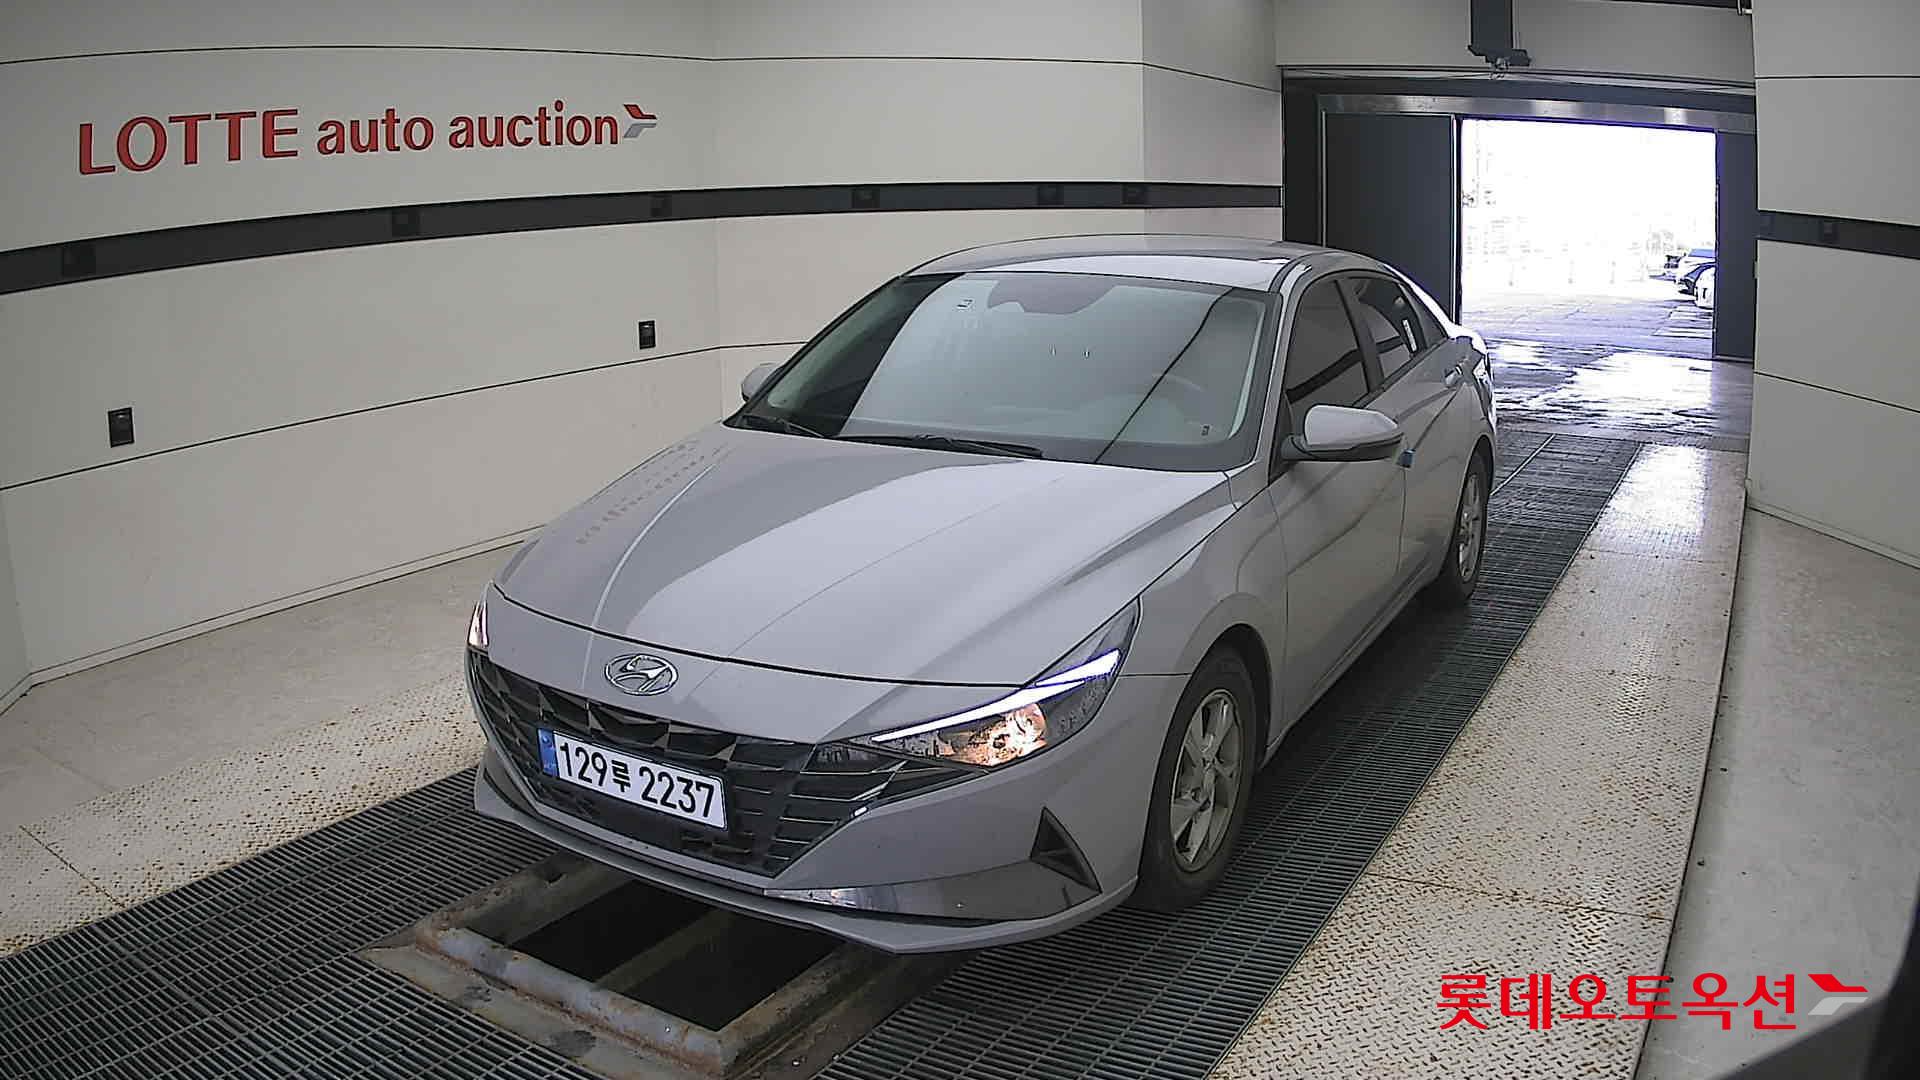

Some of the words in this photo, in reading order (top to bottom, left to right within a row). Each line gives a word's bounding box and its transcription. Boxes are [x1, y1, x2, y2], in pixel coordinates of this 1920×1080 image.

[78, 108, 298, 175] LOTTE
[316, 107, 434, 155] auto
[448, 99, 619, 149] auction
[560, 742, 631, 793] 129루
[638, 765, 715, 818] 2237
